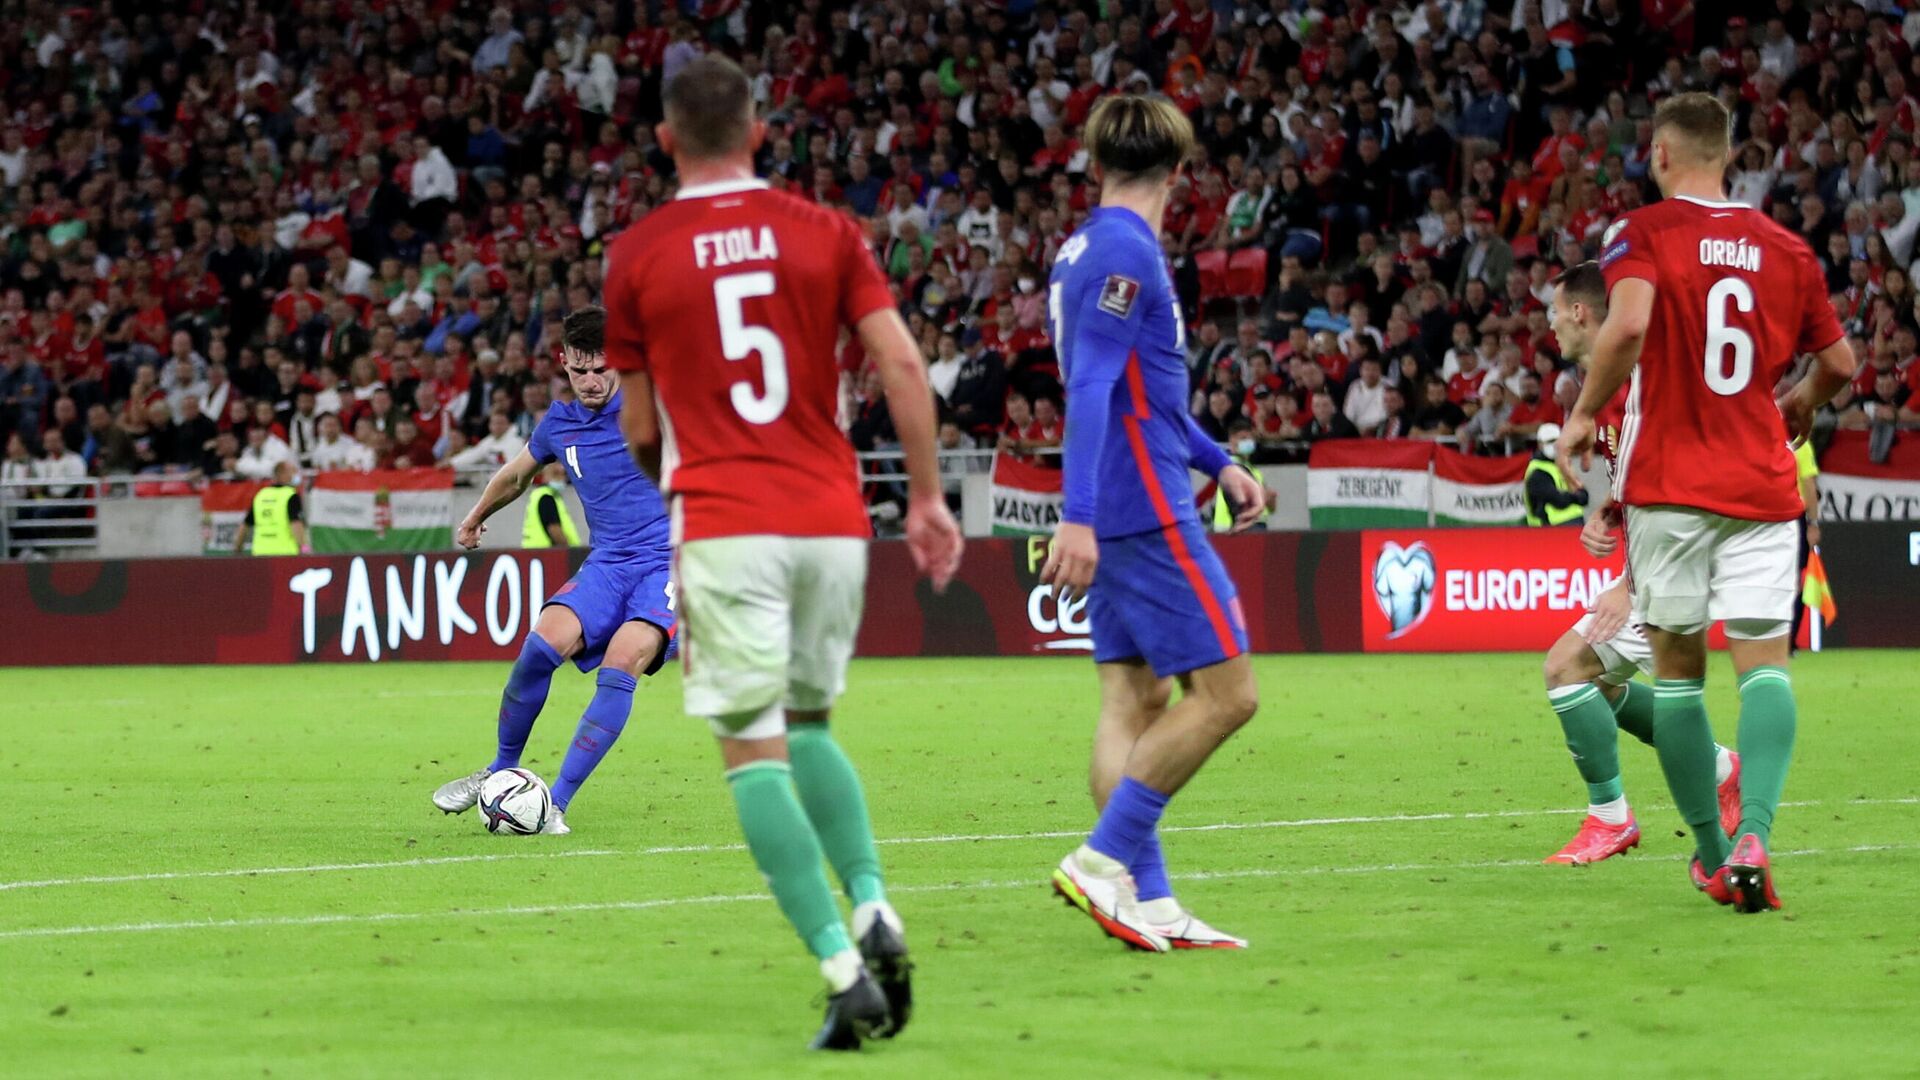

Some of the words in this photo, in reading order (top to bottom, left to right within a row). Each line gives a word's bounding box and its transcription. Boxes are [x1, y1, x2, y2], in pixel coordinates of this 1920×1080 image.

[692, 224, 779, 269] FIOLA
[1699, 237, 1761, 273] ORBÁN
[713, 270, 790, 425] 5
[1703, 276, 1754, 396] 6
[565, 445, 583, 479] 4
[1336, 475, 1402, 498] ZEBEGÉNY
[1816, 488, 1919, 521] ALOT
[1445, 567, 1612, 611] EUROPEAN
